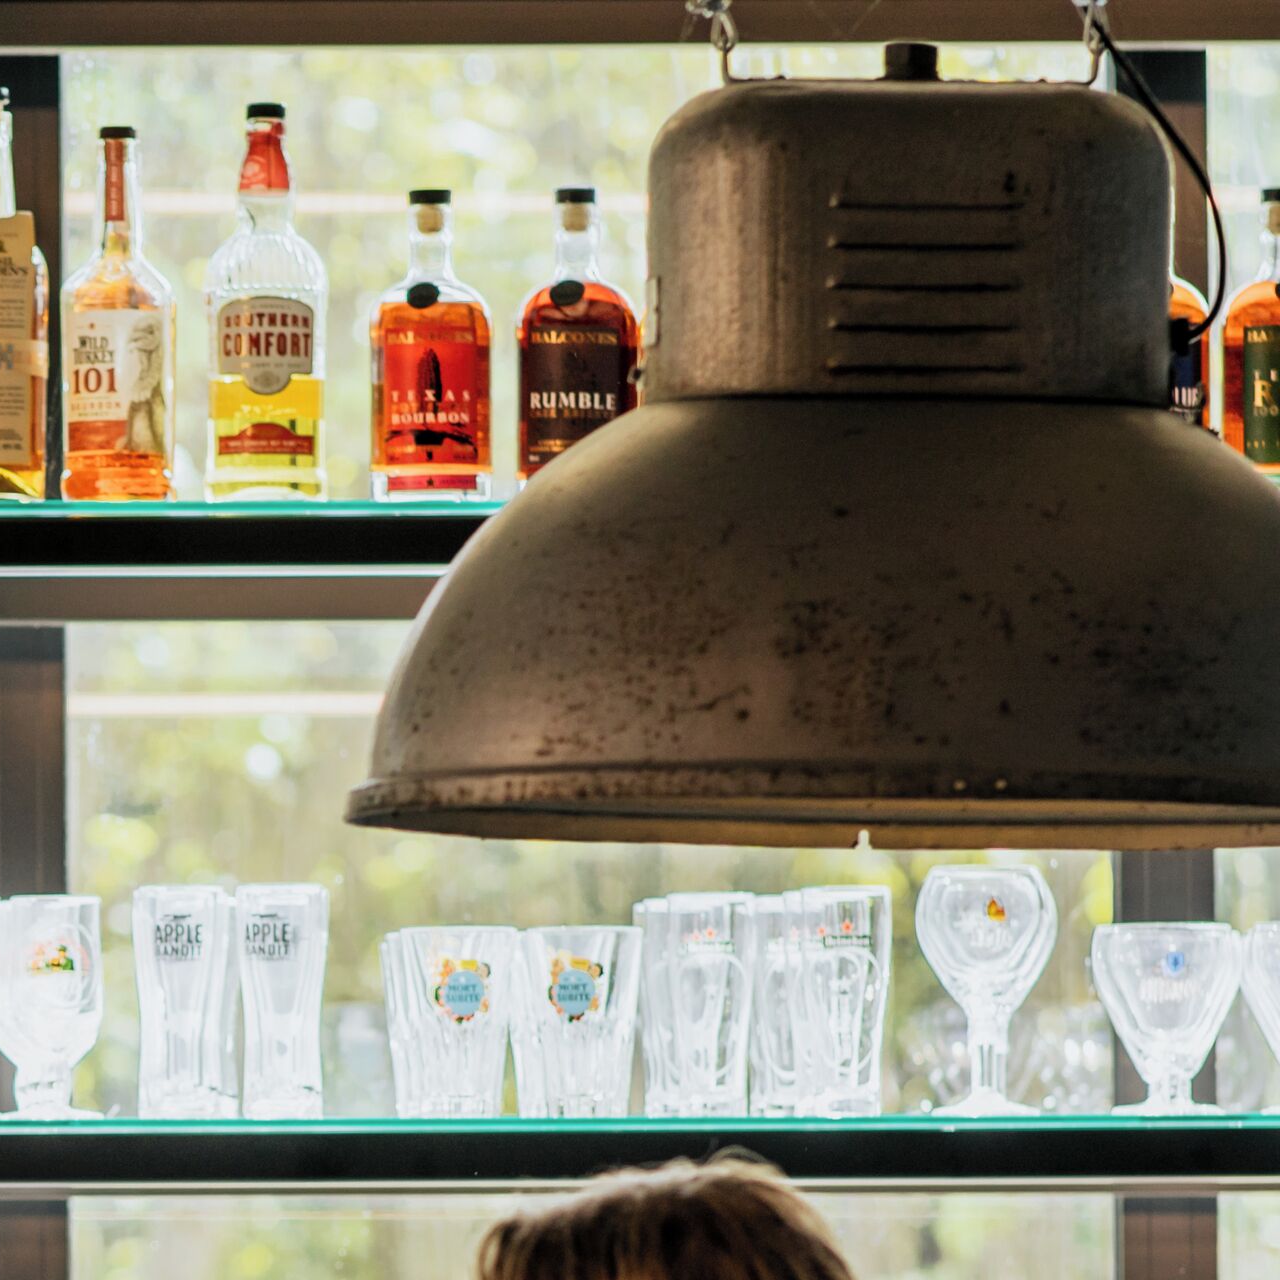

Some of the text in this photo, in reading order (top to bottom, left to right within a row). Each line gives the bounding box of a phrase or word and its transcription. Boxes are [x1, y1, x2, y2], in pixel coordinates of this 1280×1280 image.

[224, 312, 310, 329] SOUTHERN
[78, 335, 110, 350] WILD
[223, 332, 311, 357] COMFORT
[73, 348, 116, 365] TURKEY
[72, 367, 118, 395] 101
[391, 389, 471, 403] TEXAS
[529, 391, 617, 411] RUMBLE
[391, 412, 471, 426] BOURBON
[154, 924, 203, 943] APPLE
[245, 923, 290, 943] APPLE
